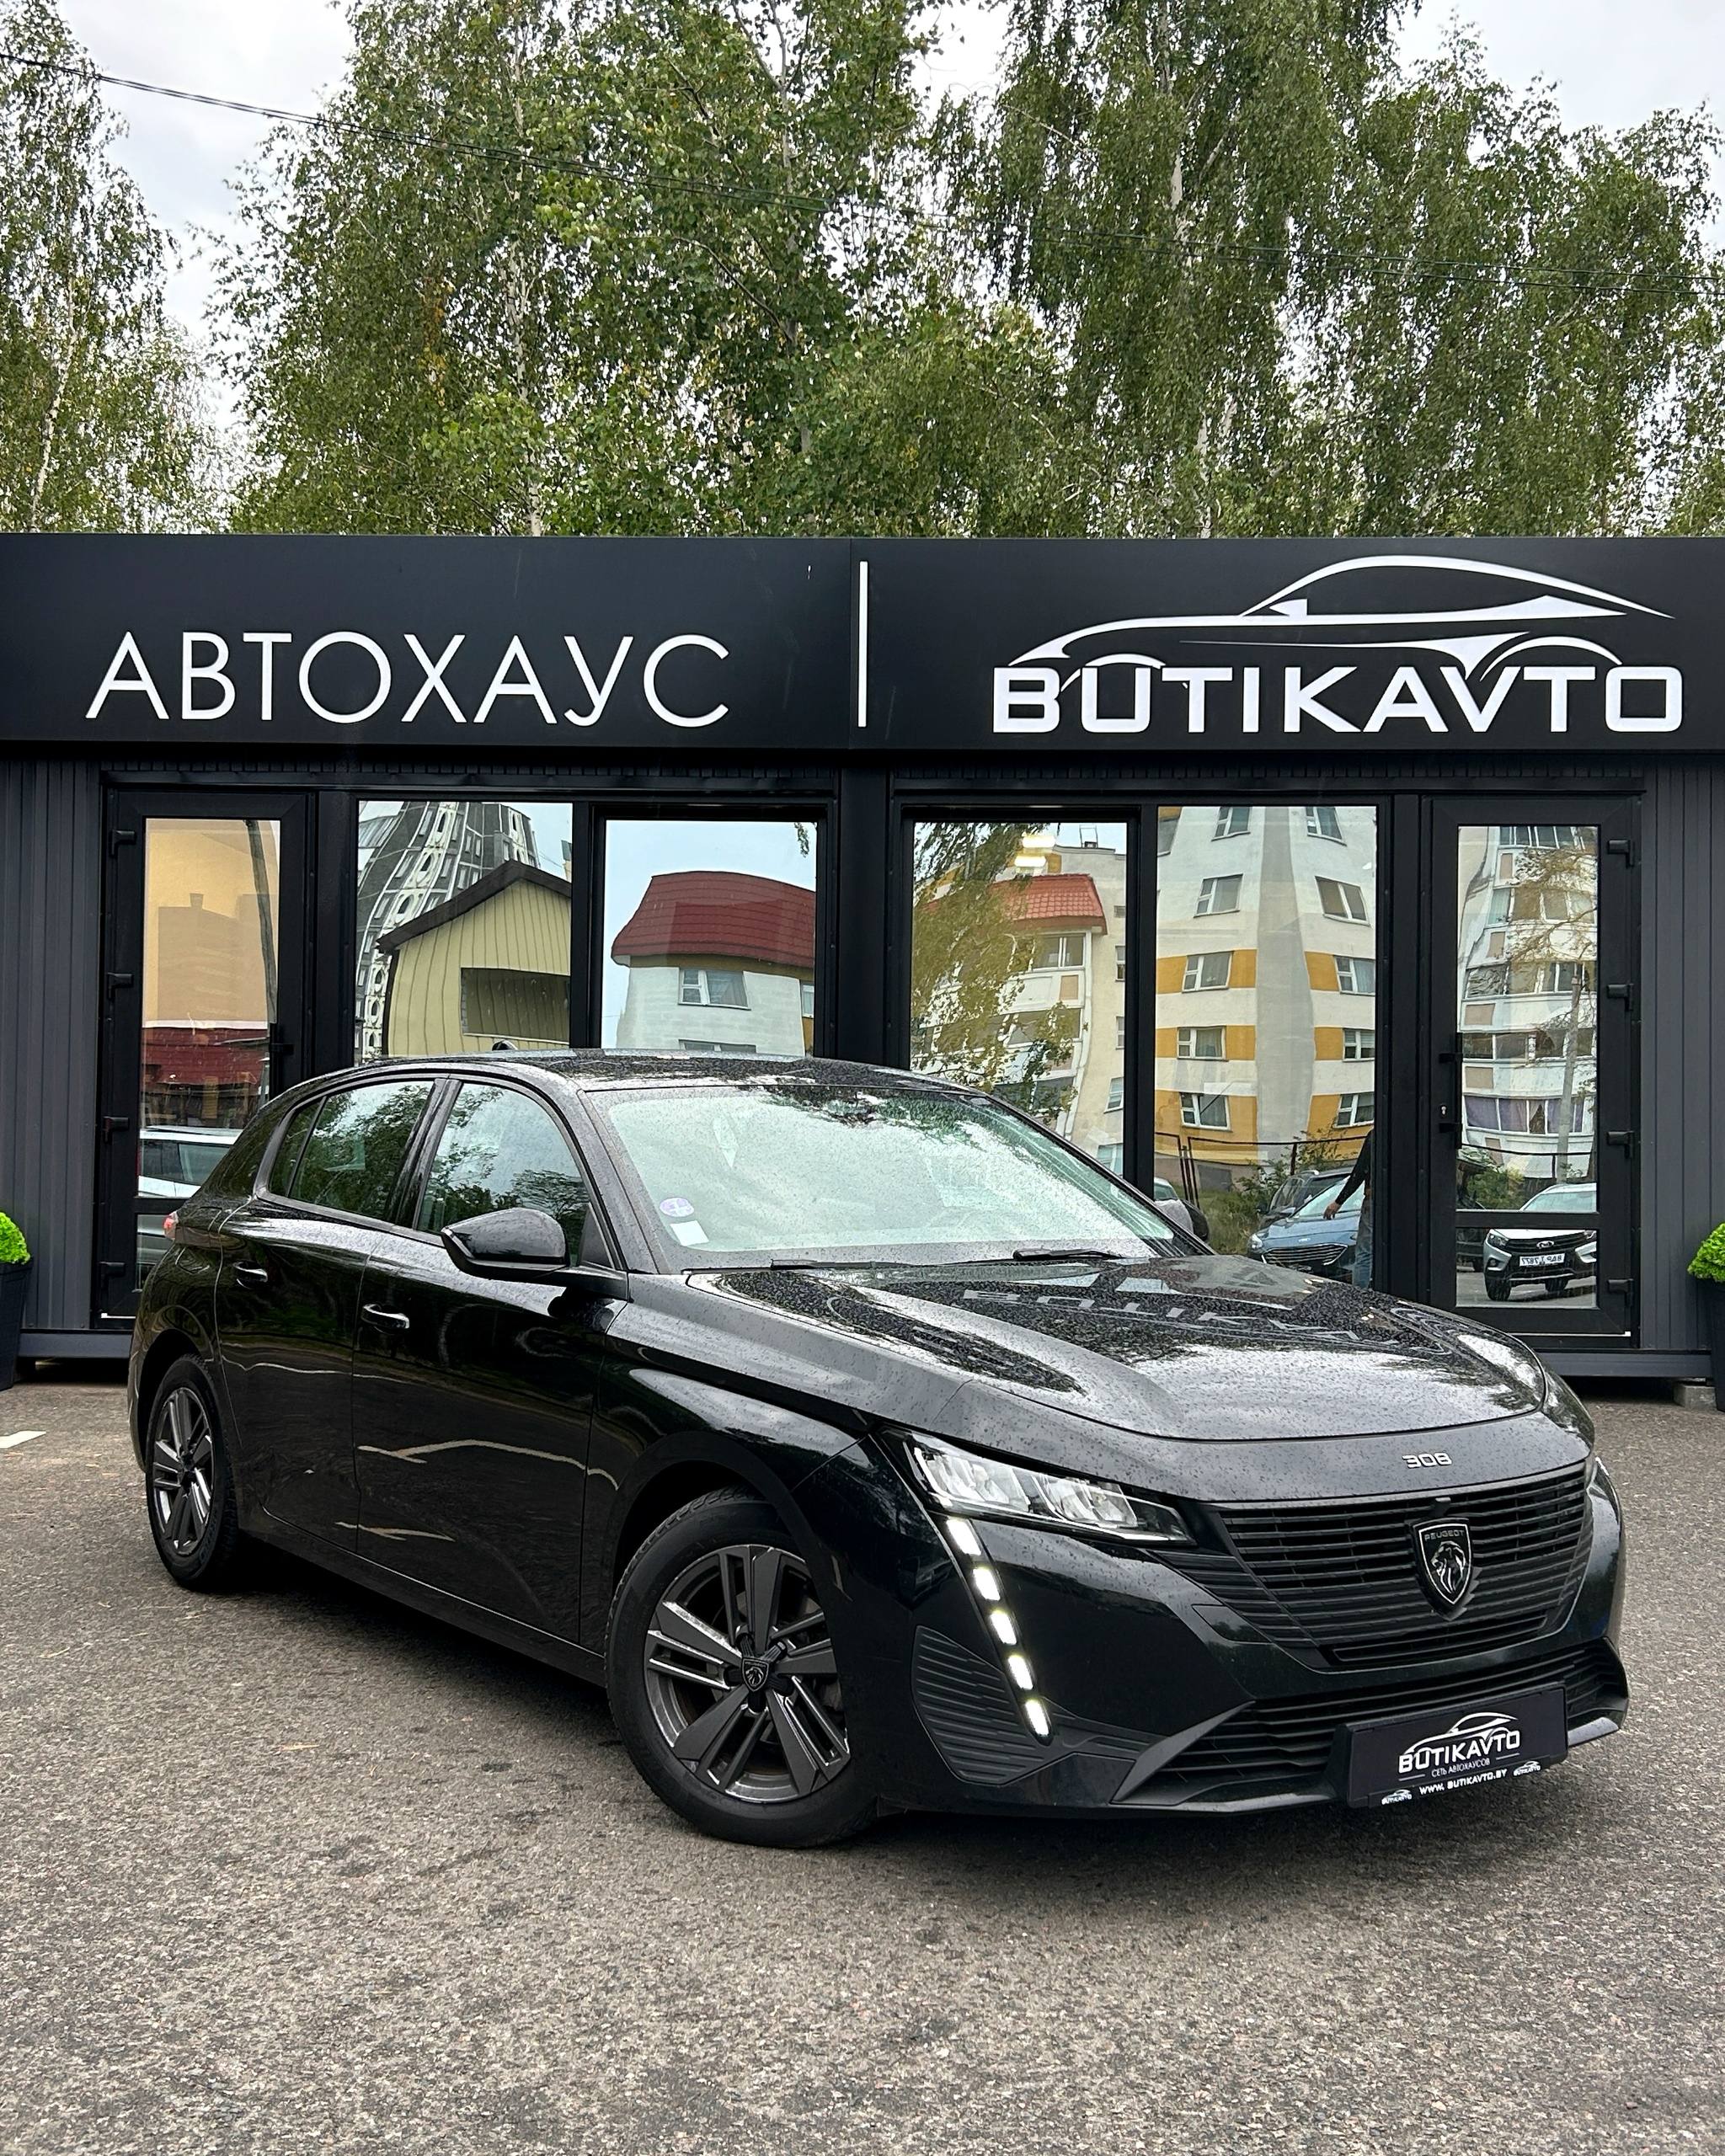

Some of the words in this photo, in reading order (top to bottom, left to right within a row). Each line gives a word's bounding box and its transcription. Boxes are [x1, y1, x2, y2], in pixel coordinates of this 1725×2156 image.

[86, 631, 730, 728] АВТОХАУС
[992, 664, 1683, 734] BUTIKAVTO
[1402, 1452, 1452, 1469] 308
[1424, 1529, 1466, 1541] PEUGEOT
[1398, 1730, 1520, 1774] BUTIKAVTO
[1432, 1767, 1448, 1778] СЕТЬ
[1448, 1757, 1491, 1774] АВТОХАУСОВ
